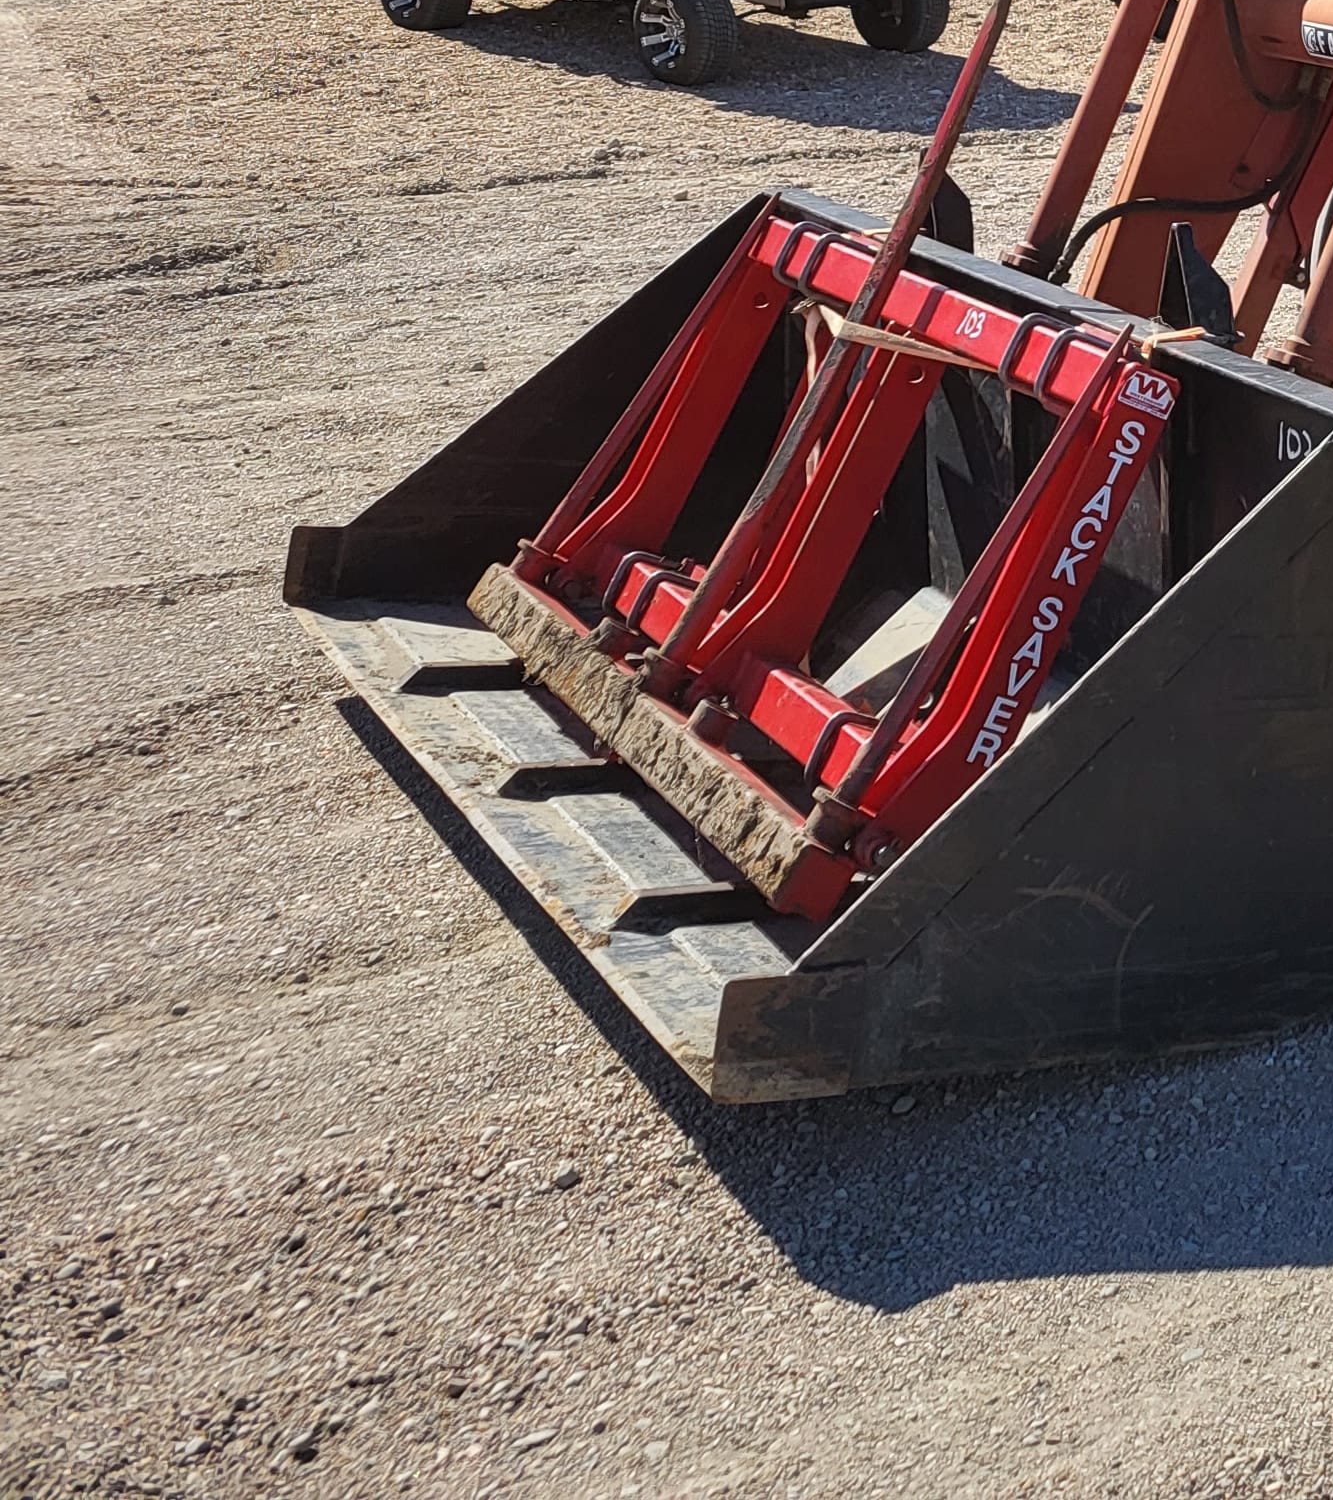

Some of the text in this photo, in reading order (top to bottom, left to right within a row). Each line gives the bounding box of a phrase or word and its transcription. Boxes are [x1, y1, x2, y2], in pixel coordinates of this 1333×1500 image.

[955, 308, 986, 338] 103
[1135, 373, 1169, 400] W
[1051, 420, 1146, 586] STACK
[966, 596, 1064, 768] SAVER
